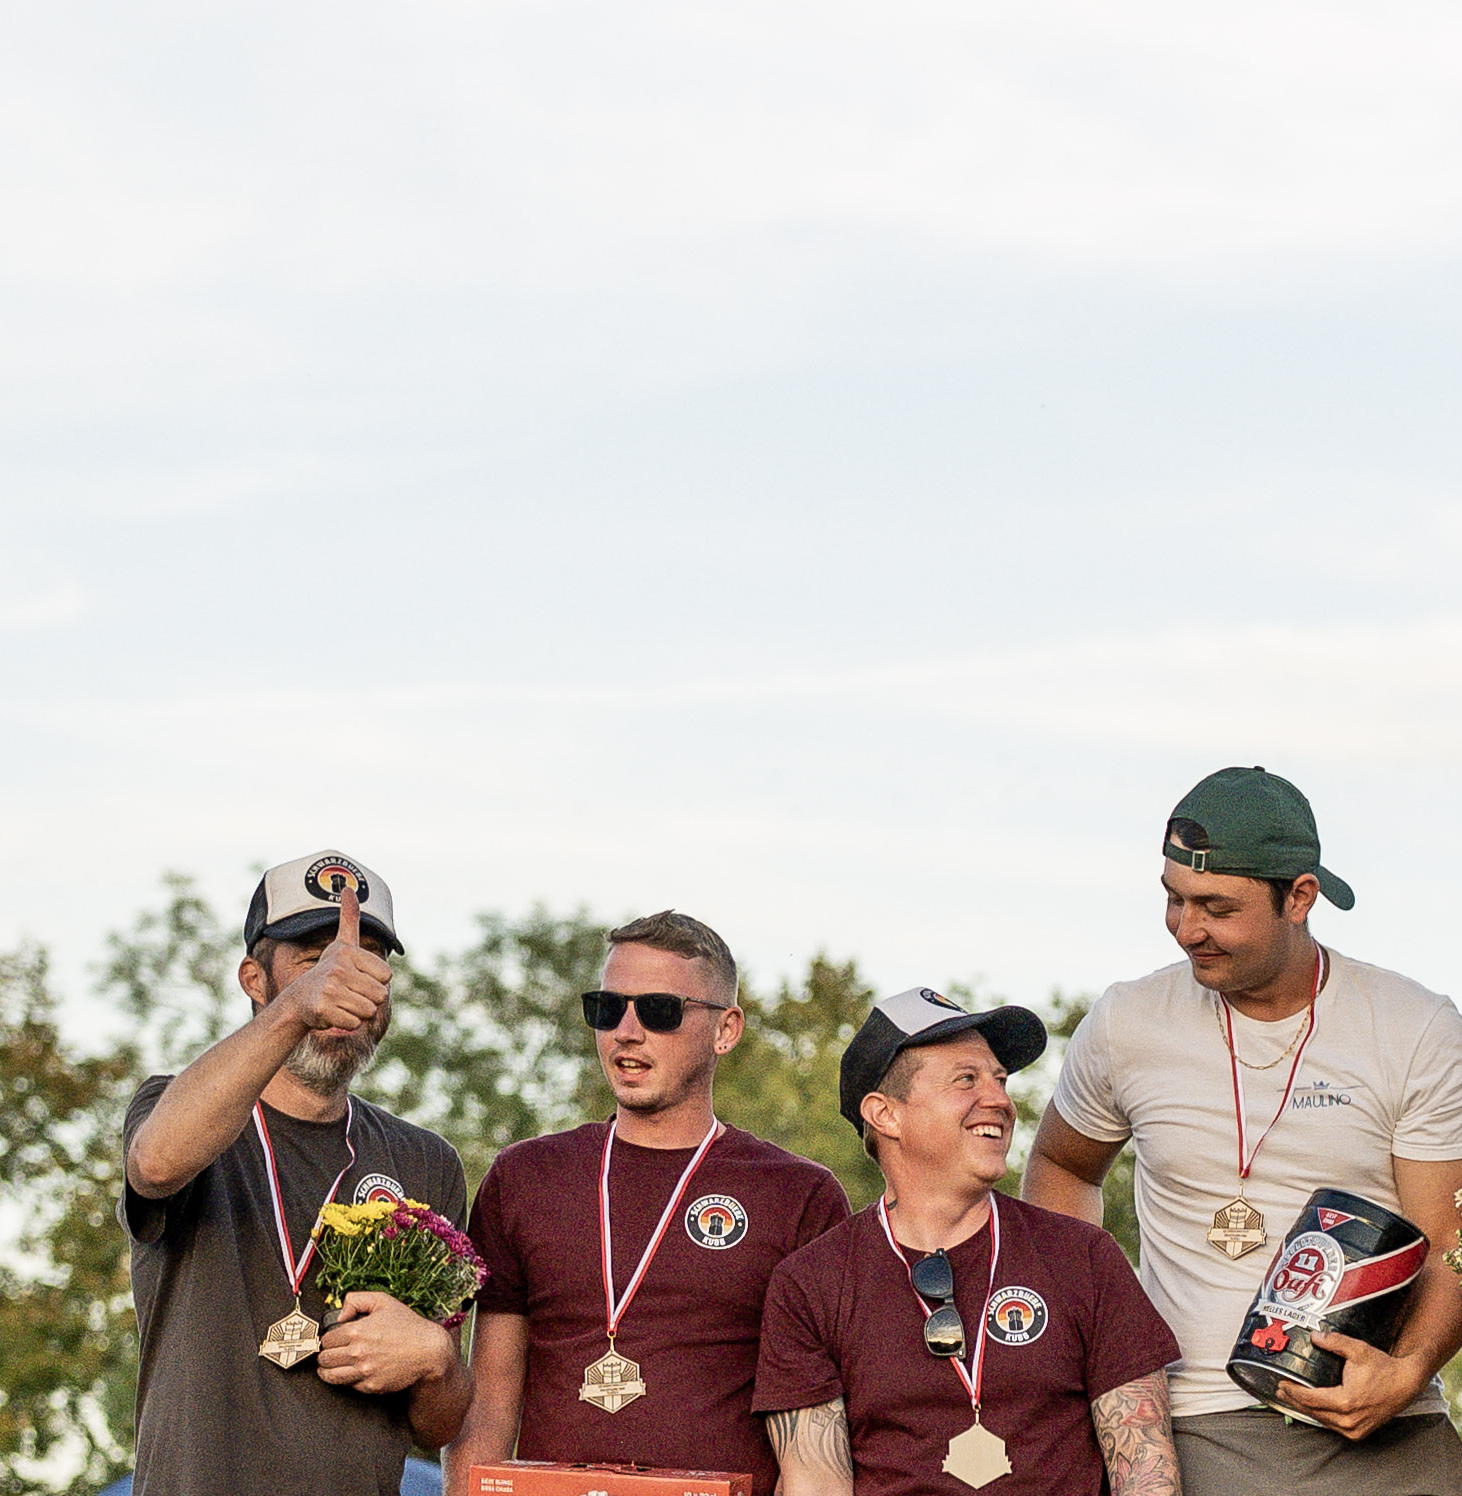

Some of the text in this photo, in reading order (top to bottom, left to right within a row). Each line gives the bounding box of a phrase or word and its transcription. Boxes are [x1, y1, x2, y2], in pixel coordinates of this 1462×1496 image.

[1292, 1093, 1352, 1110] MAULINO
[1295, 1253, 1319, 1272] 11
[1005, 1331, 1030, 1343] KUBB
